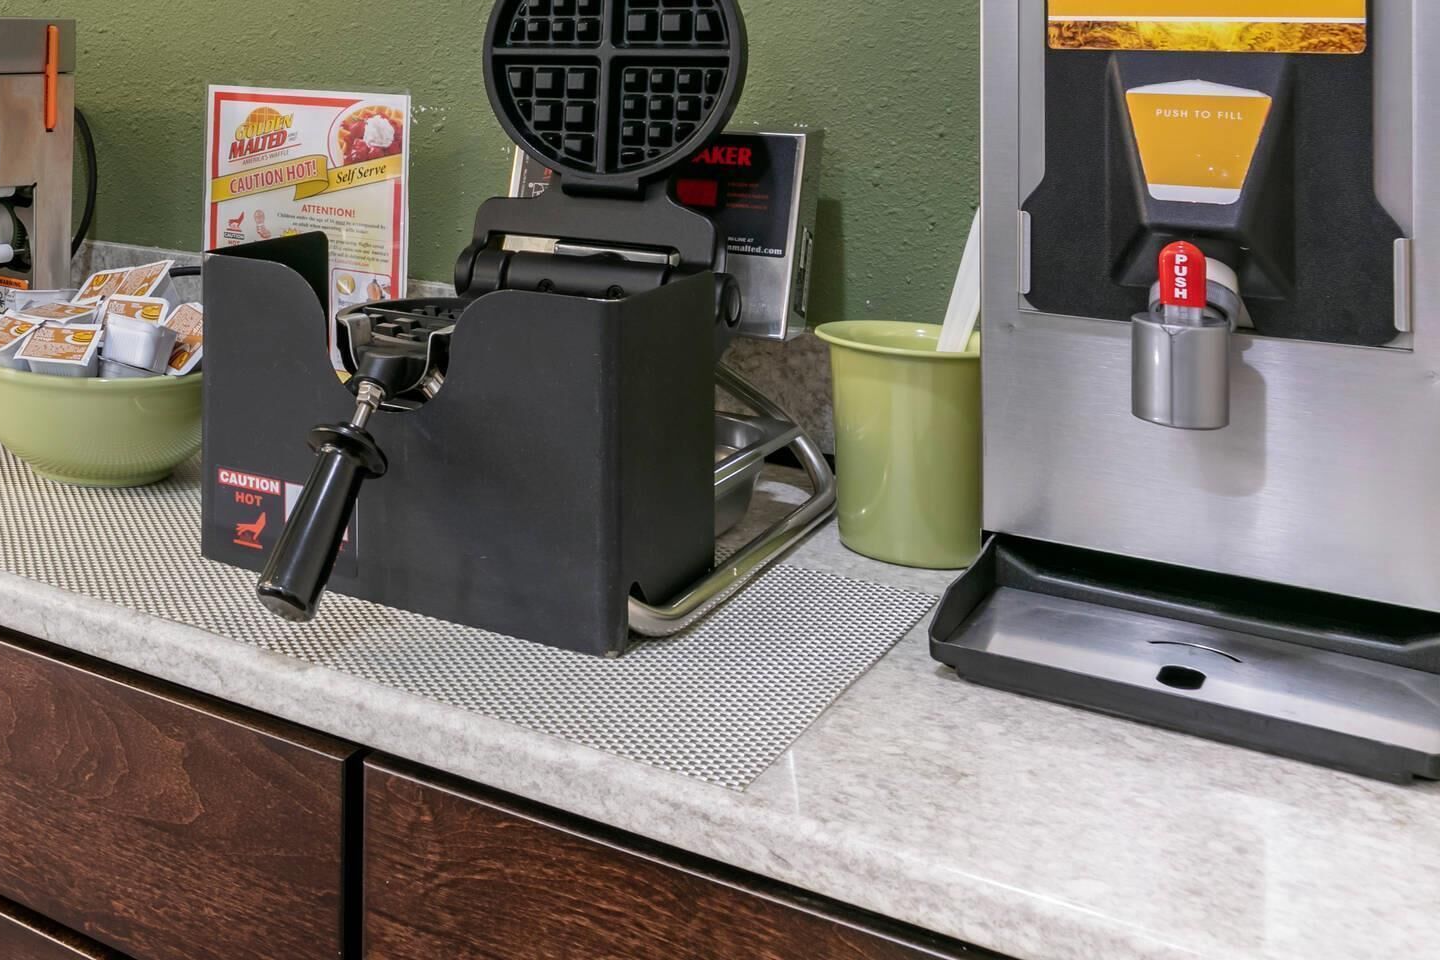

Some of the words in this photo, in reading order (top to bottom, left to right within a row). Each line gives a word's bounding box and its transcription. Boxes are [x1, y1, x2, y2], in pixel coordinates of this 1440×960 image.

[1156, 108, 1188, 119] PUSH
[1194, 109, 1210, 119] TO
[1217, 110, 1243, 120] FILL
[235, 111, 294, 140] GOLDEN
[229, 130, 287, 160] MALTED
[692, 144, 752, 167] AKER
[230, 168, 283, 194] CAUTION
[286, 160, 318, 181] HOT!
[336, 171, 357, 185] Self
[357, 164, 386, 180] Serve
[301, 204, 355, 218] ATTENTION!
[727, 244, 783, 255] nmalted.com
[1174, 254, 1187, 300] PUSH
[220, 471, 279, 493] CAUTION
[235, 492, 262, 506] HOT
